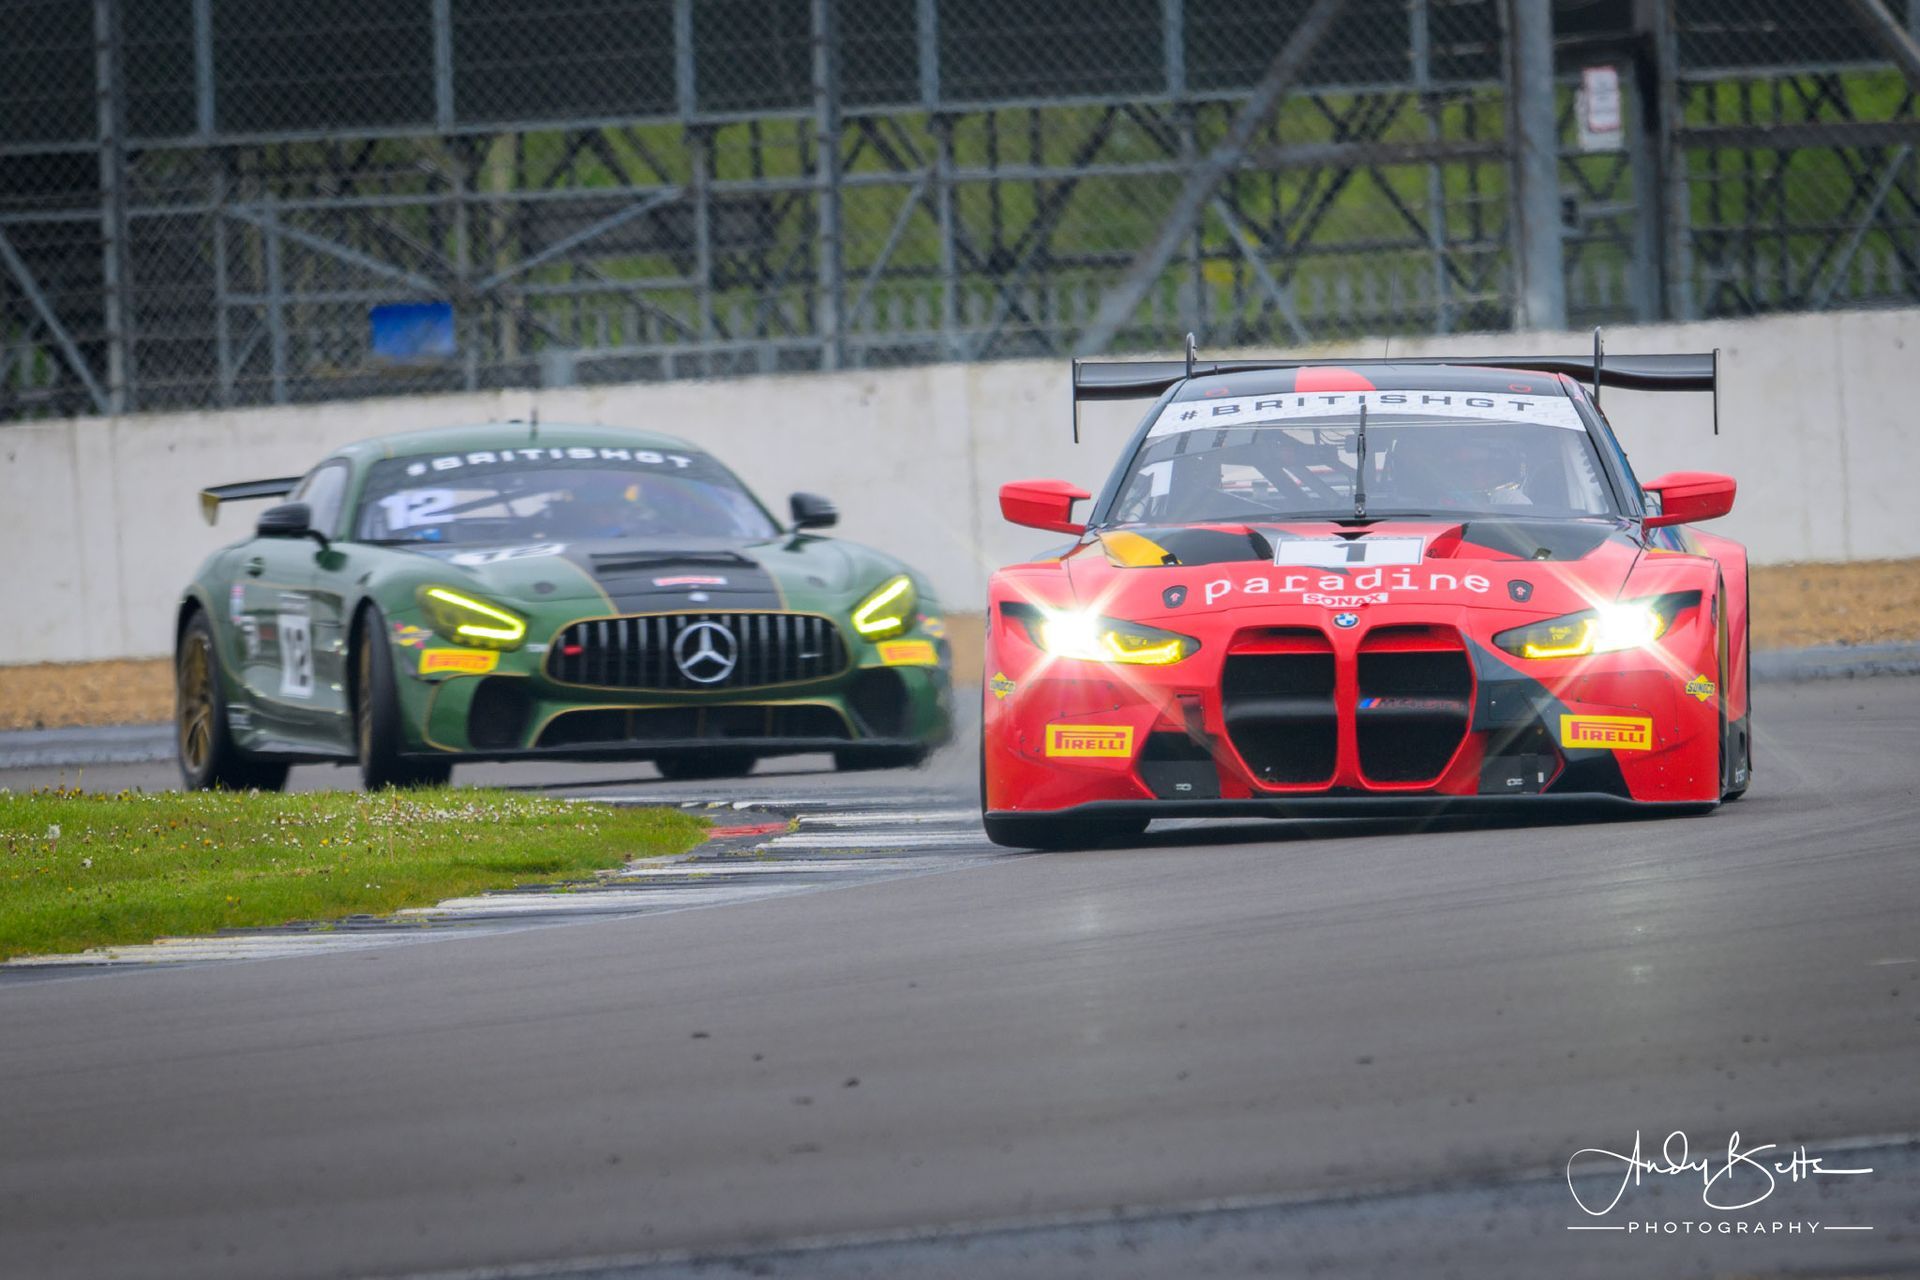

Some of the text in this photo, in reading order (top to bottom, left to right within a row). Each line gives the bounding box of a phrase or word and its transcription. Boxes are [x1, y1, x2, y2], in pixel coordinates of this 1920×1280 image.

[1179, 394, 1535, 422] #BRITISHGT
[1138, 460, 1174, 497] 1
[378, 487, 456, 531] 12
[1333, 543, 1367, 562] 1
[1205, 568, 1491, 605] paradine
[1306, 594, 1381, 606] SONAX
[1055, 731, 1126, 750] PIRELLI
[1571, 721, 1646, 743] PIRELLI
